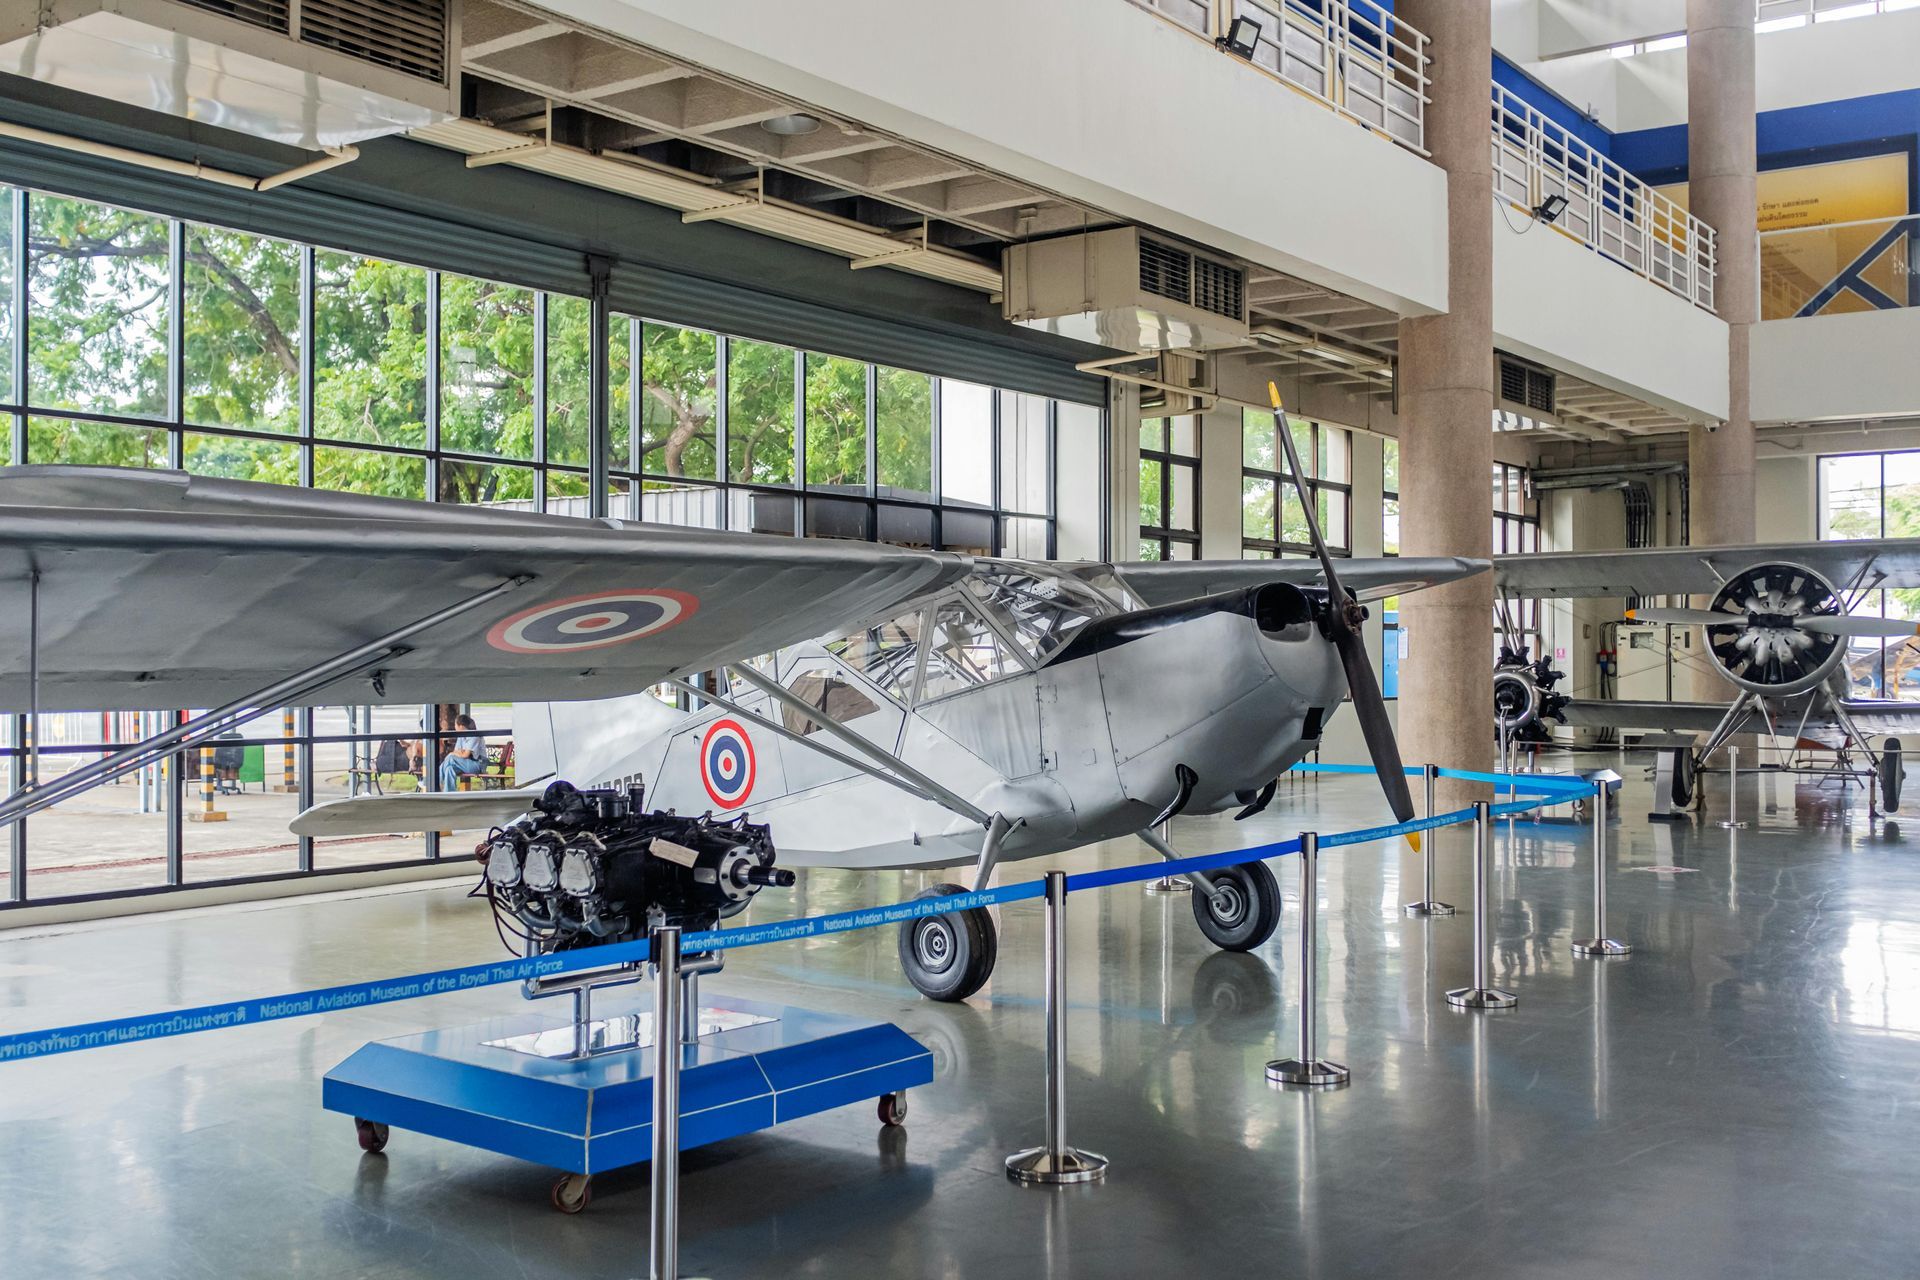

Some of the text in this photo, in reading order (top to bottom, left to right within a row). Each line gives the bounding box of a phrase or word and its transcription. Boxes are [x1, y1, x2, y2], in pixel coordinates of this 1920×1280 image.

[823, 894, 995, 931] National Aviation Museum of the Royal Thai Air Force
[260, 959, 563, 1019] National Aviation Museum of the Royal Thai Air Force
